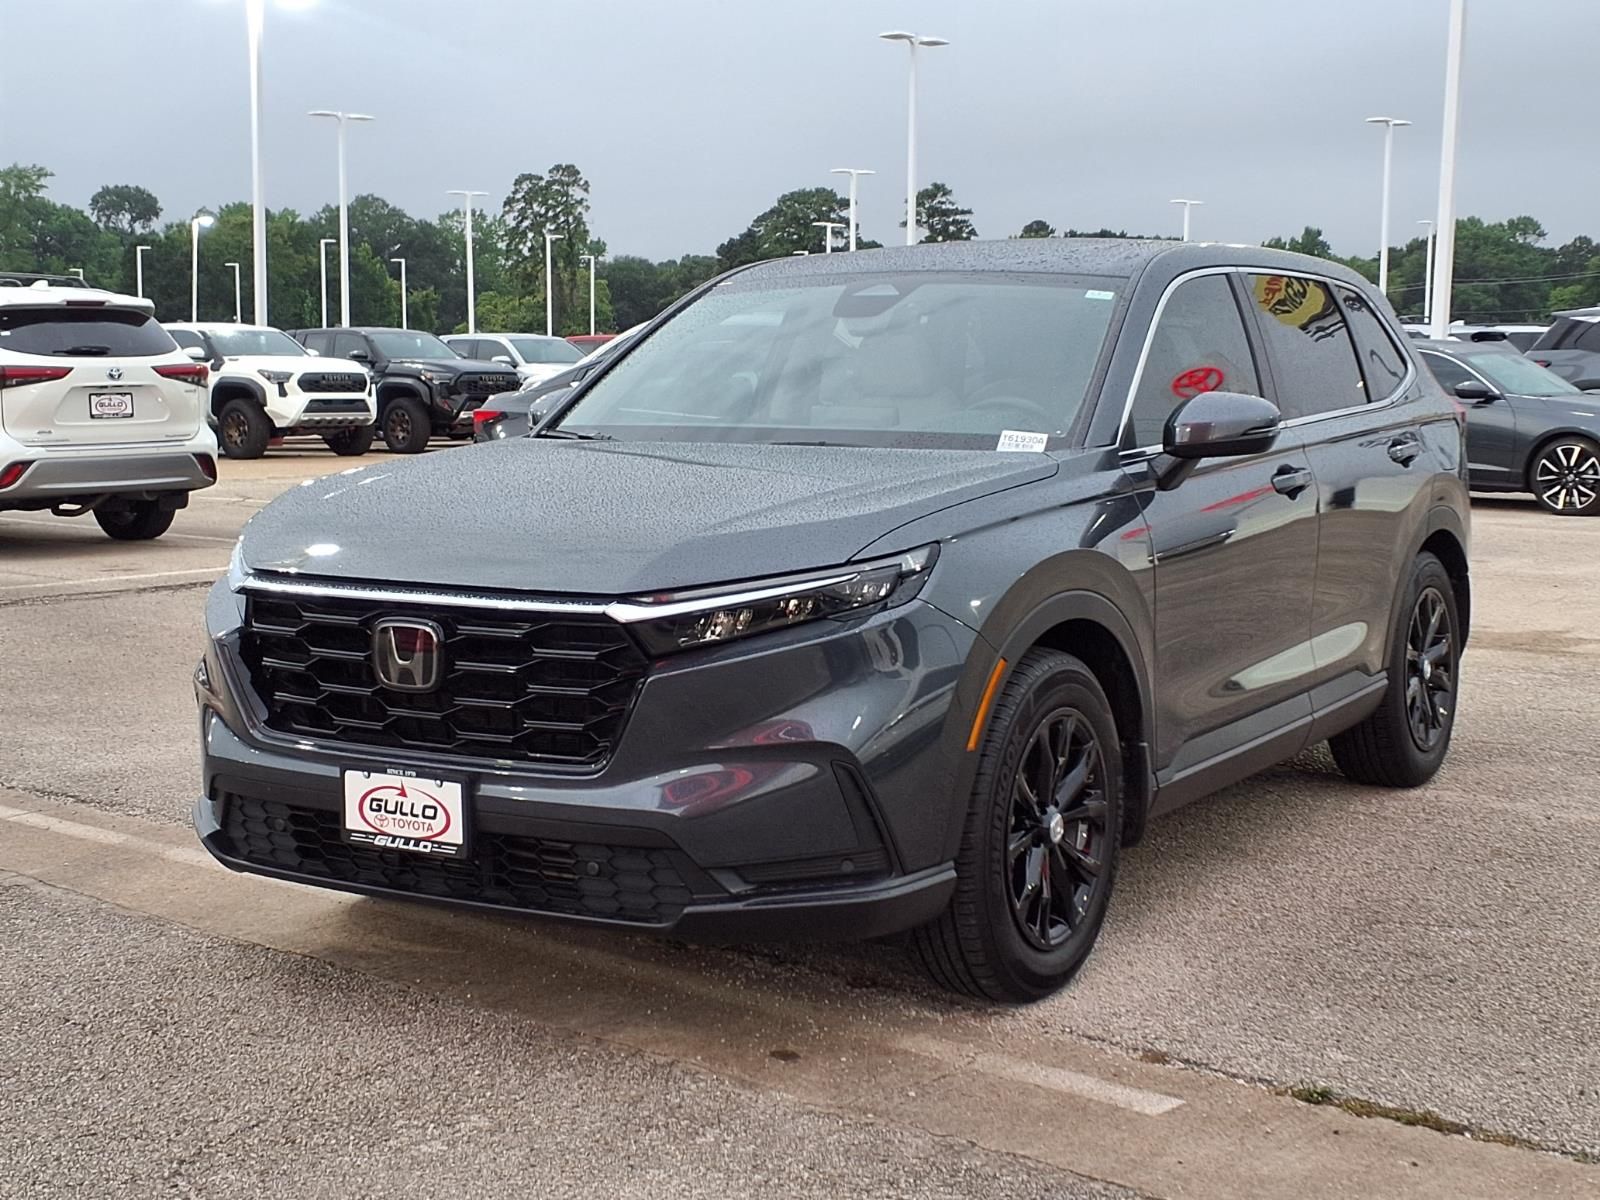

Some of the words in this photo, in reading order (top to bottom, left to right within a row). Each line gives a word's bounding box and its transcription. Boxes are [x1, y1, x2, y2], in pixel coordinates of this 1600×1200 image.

[369, 797, 438, 820] GULLO
[391, 817, 434, 833] TOYOTA
[373, 834, 432, 853] GULLO
